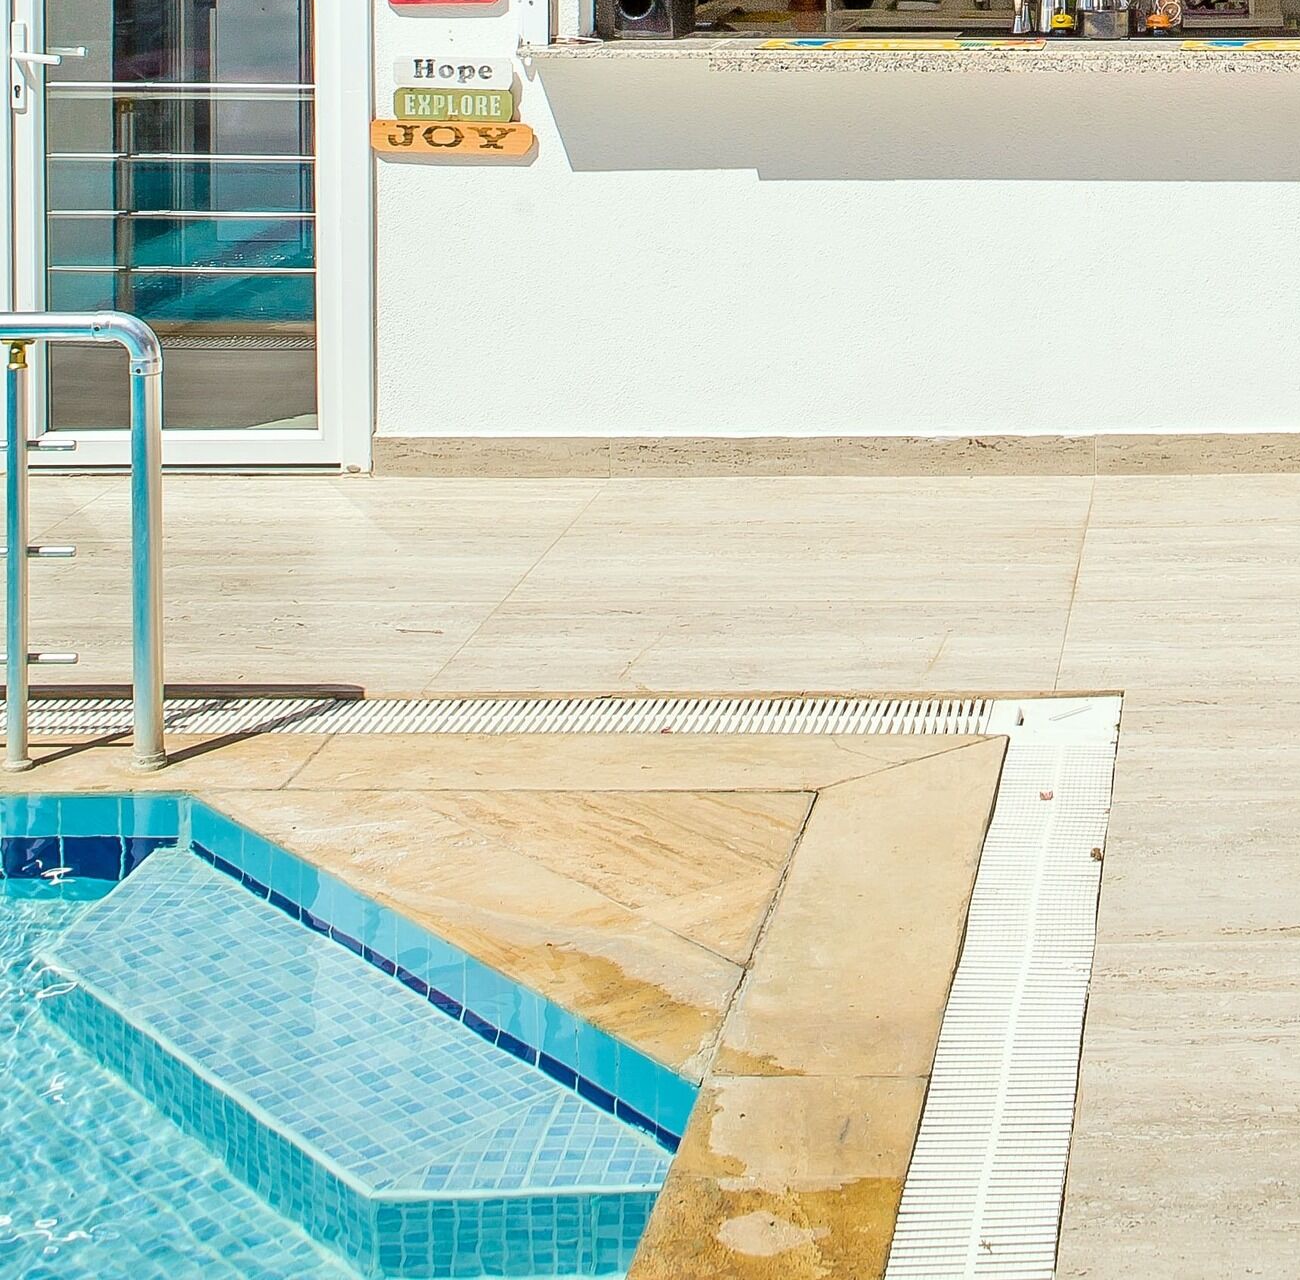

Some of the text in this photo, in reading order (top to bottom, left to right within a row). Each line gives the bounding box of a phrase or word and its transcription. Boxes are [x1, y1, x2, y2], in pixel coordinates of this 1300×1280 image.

[413, 58, 493, 83] Hope
[404, 93, 501, 117] EXPLORE
[388, 124, 516, 150] JOY
